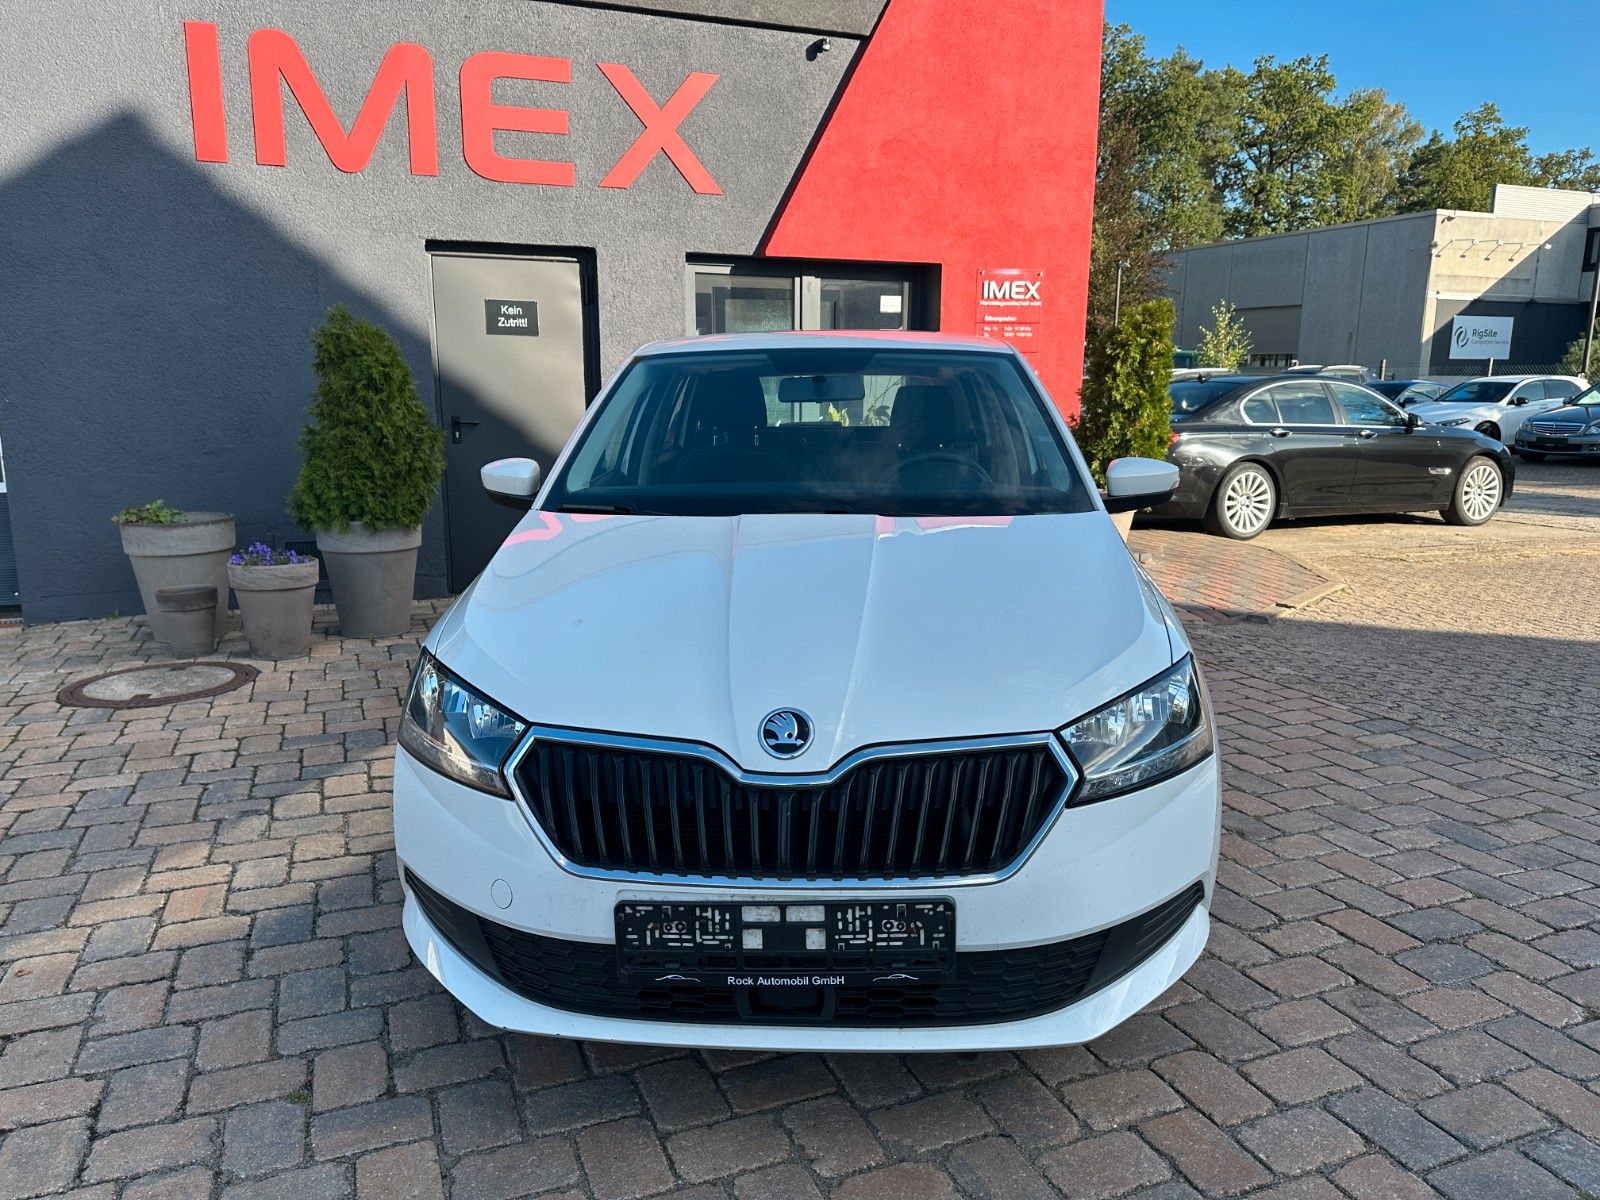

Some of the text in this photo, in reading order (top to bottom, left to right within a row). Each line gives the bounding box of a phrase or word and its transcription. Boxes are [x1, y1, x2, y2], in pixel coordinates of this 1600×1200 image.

[184, 21, 724, 195] IMEX
[983, 280, 1041, 300] IMEX
[500, 305, 523, 315] Kein
[497, 317, 528, 328] Zutritt!
[1472, 328, 1498, 339] RigSite
[727, 975, 845, 985] Rock Automobil GmbH
